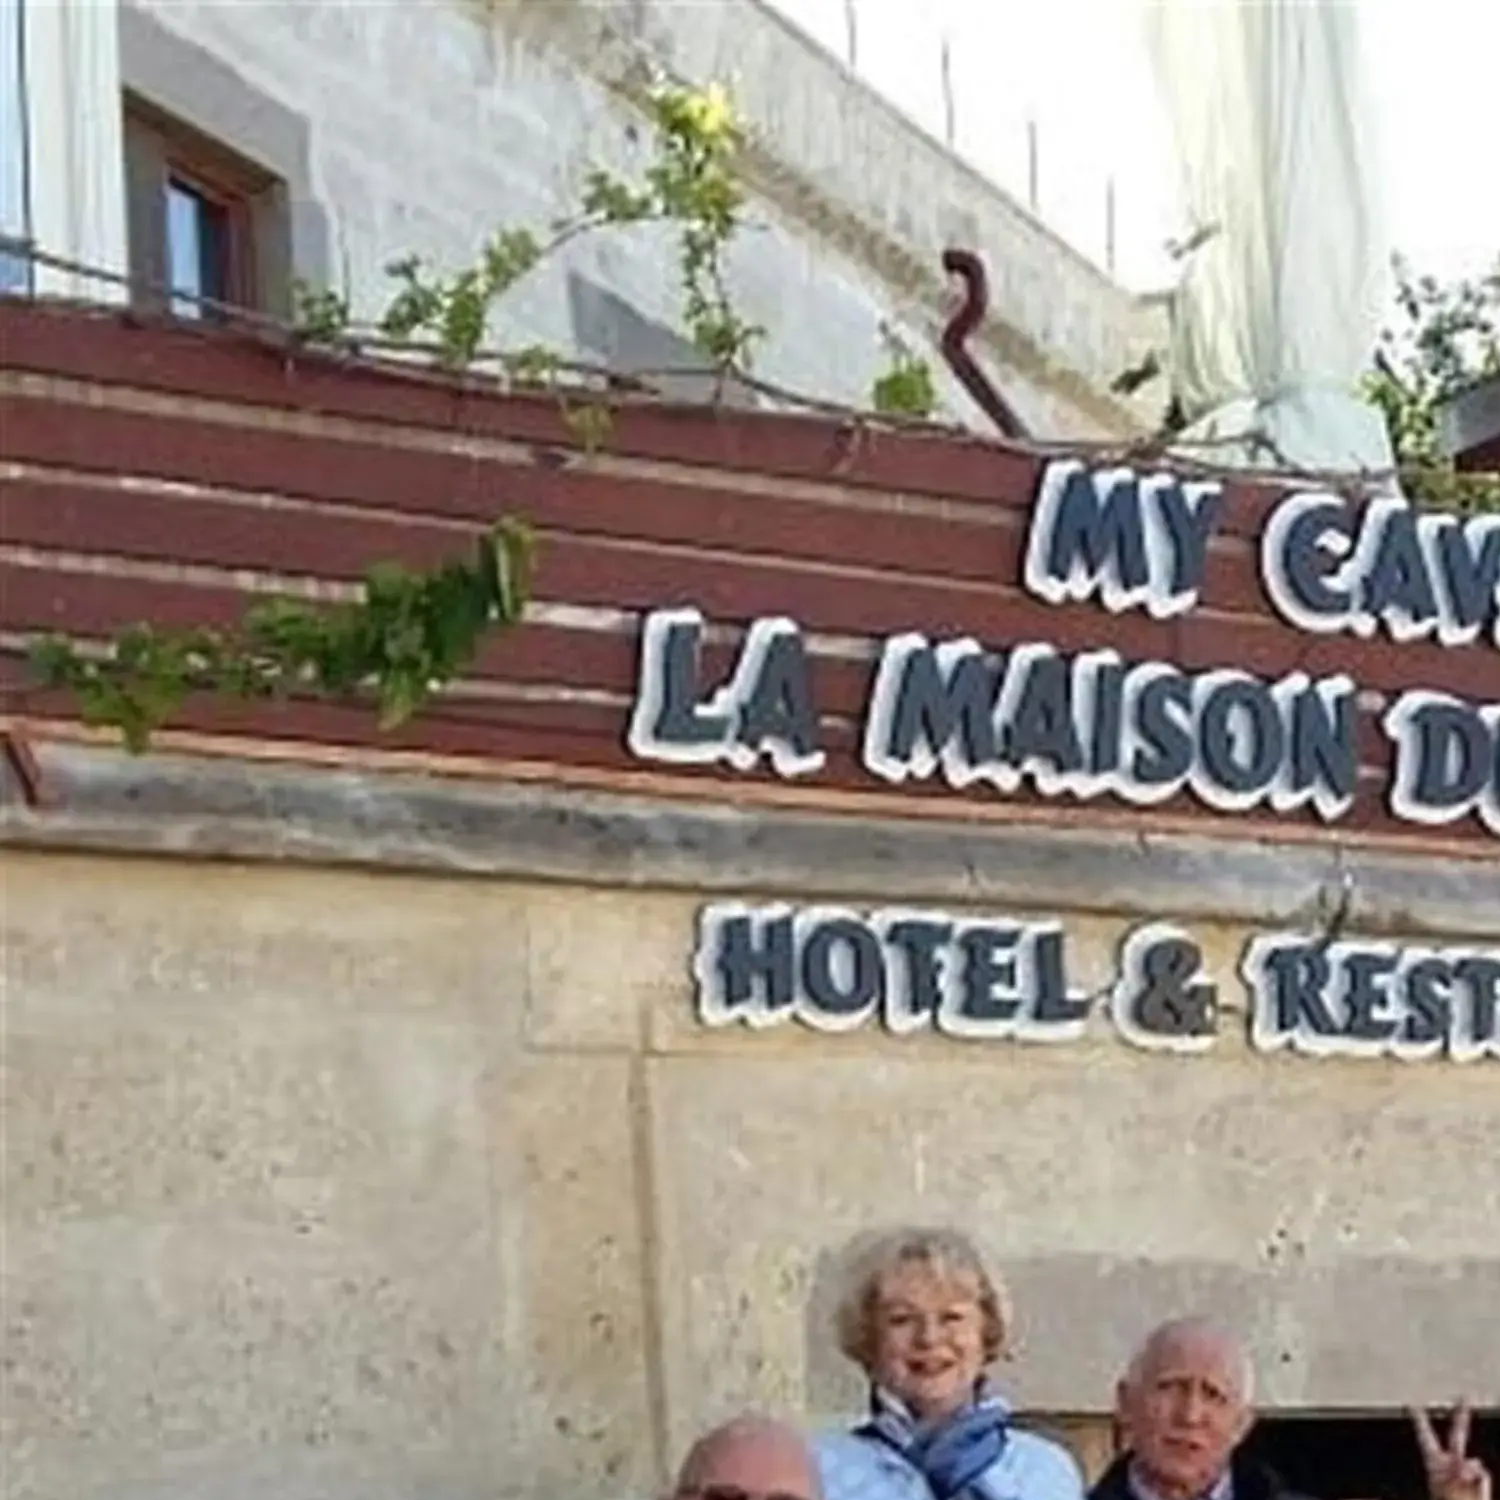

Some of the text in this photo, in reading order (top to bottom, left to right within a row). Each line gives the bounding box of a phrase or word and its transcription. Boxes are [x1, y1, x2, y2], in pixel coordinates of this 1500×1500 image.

[1024, 461, 1222, 617] MY
[628, 608, 825, 776] LA
[864, 633, 1354, 821] MAISON
[696, 903, 1089, 1040] HOTEL
[1112, 922, 1217, 1052] &
